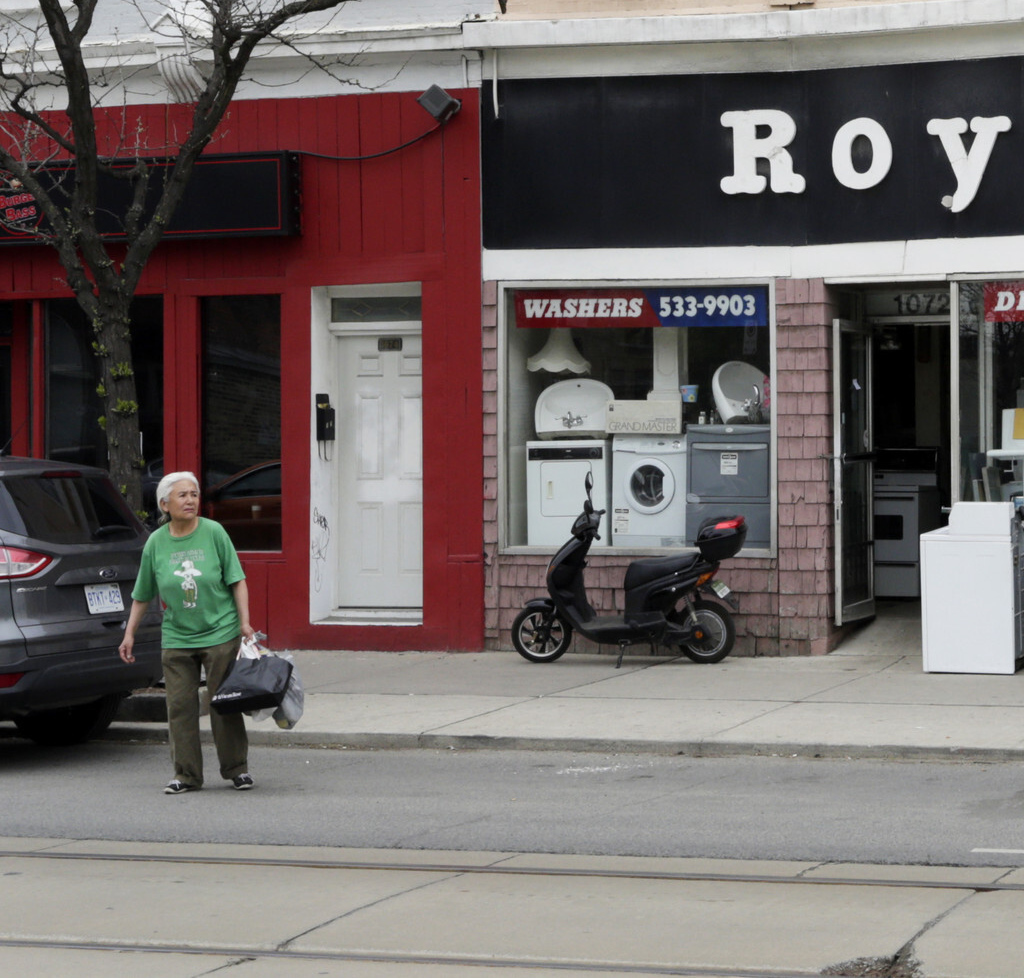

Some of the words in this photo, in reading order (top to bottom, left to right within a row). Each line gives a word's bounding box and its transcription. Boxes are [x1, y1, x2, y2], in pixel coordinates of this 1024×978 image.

[0, 193, 35, 209] BURGE
[523, 296, 644, 319] WASHERS
[659, 293, 757, 318] 533-9903
[893, 293, 950, 314] 1072
[642, 421, 677, 431] MASTER
